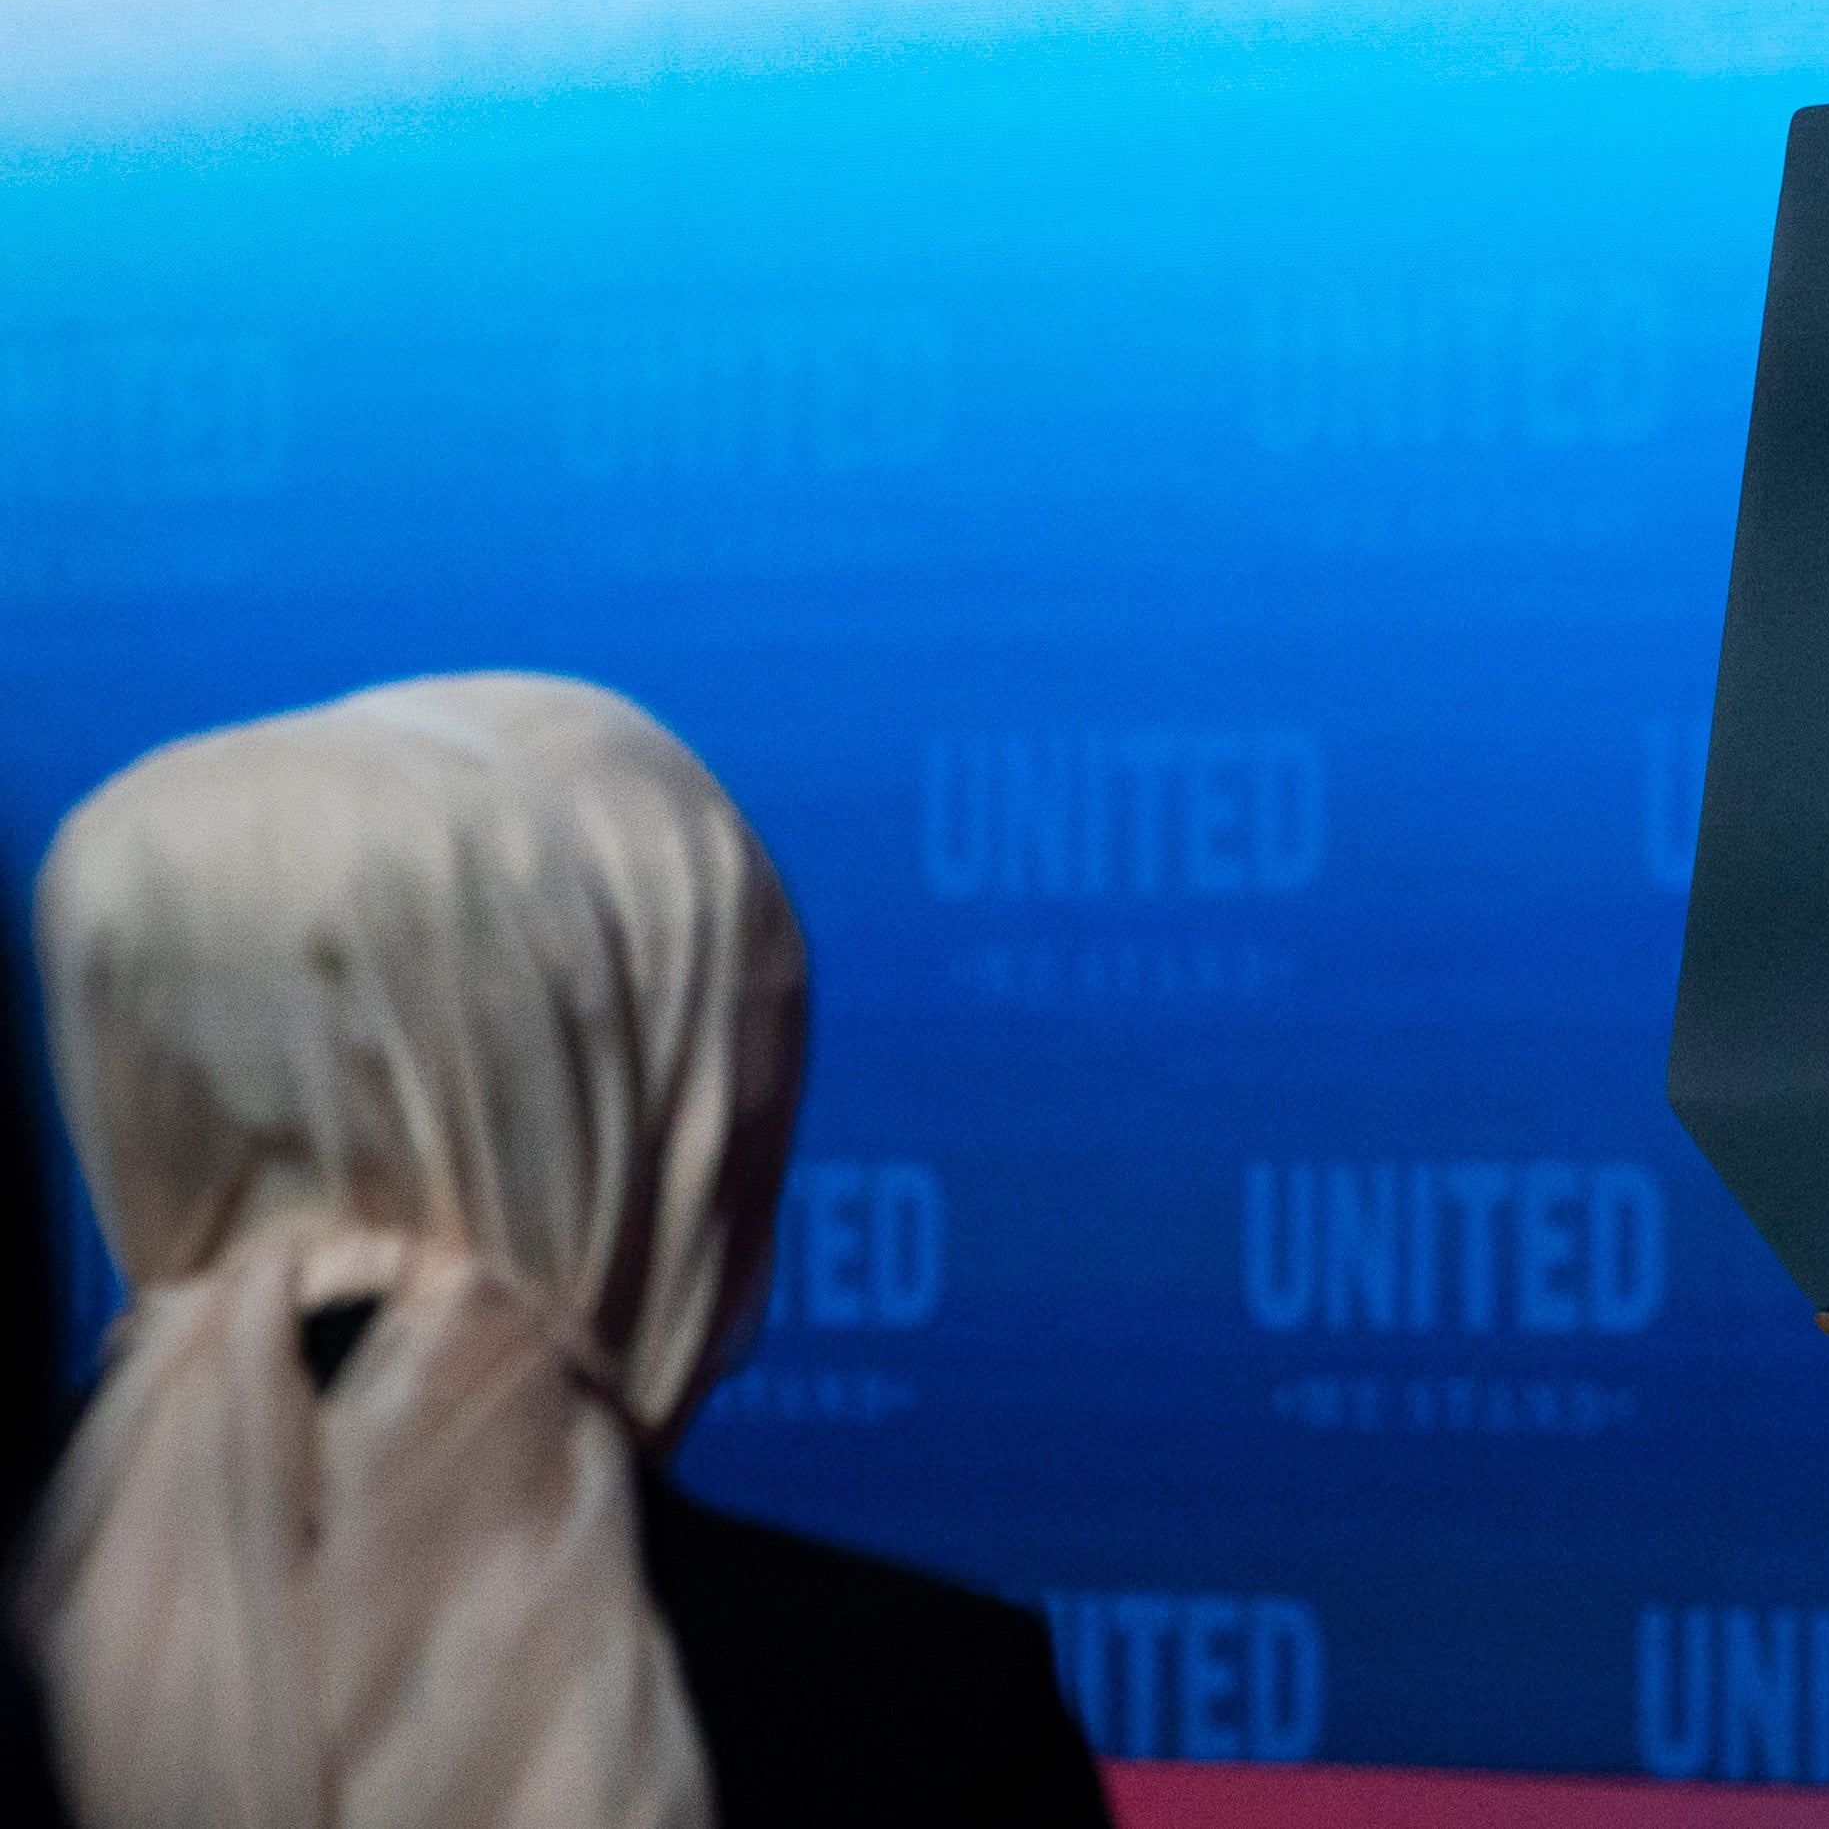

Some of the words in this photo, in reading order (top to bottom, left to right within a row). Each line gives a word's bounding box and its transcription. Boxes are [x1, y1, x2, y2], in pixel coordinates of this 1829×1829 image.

[1250, 277, 1662, 459] UNITED
[921, 729, 1327, 900] UNITED
[1246, 1162, 1665, 1334] UNITED
